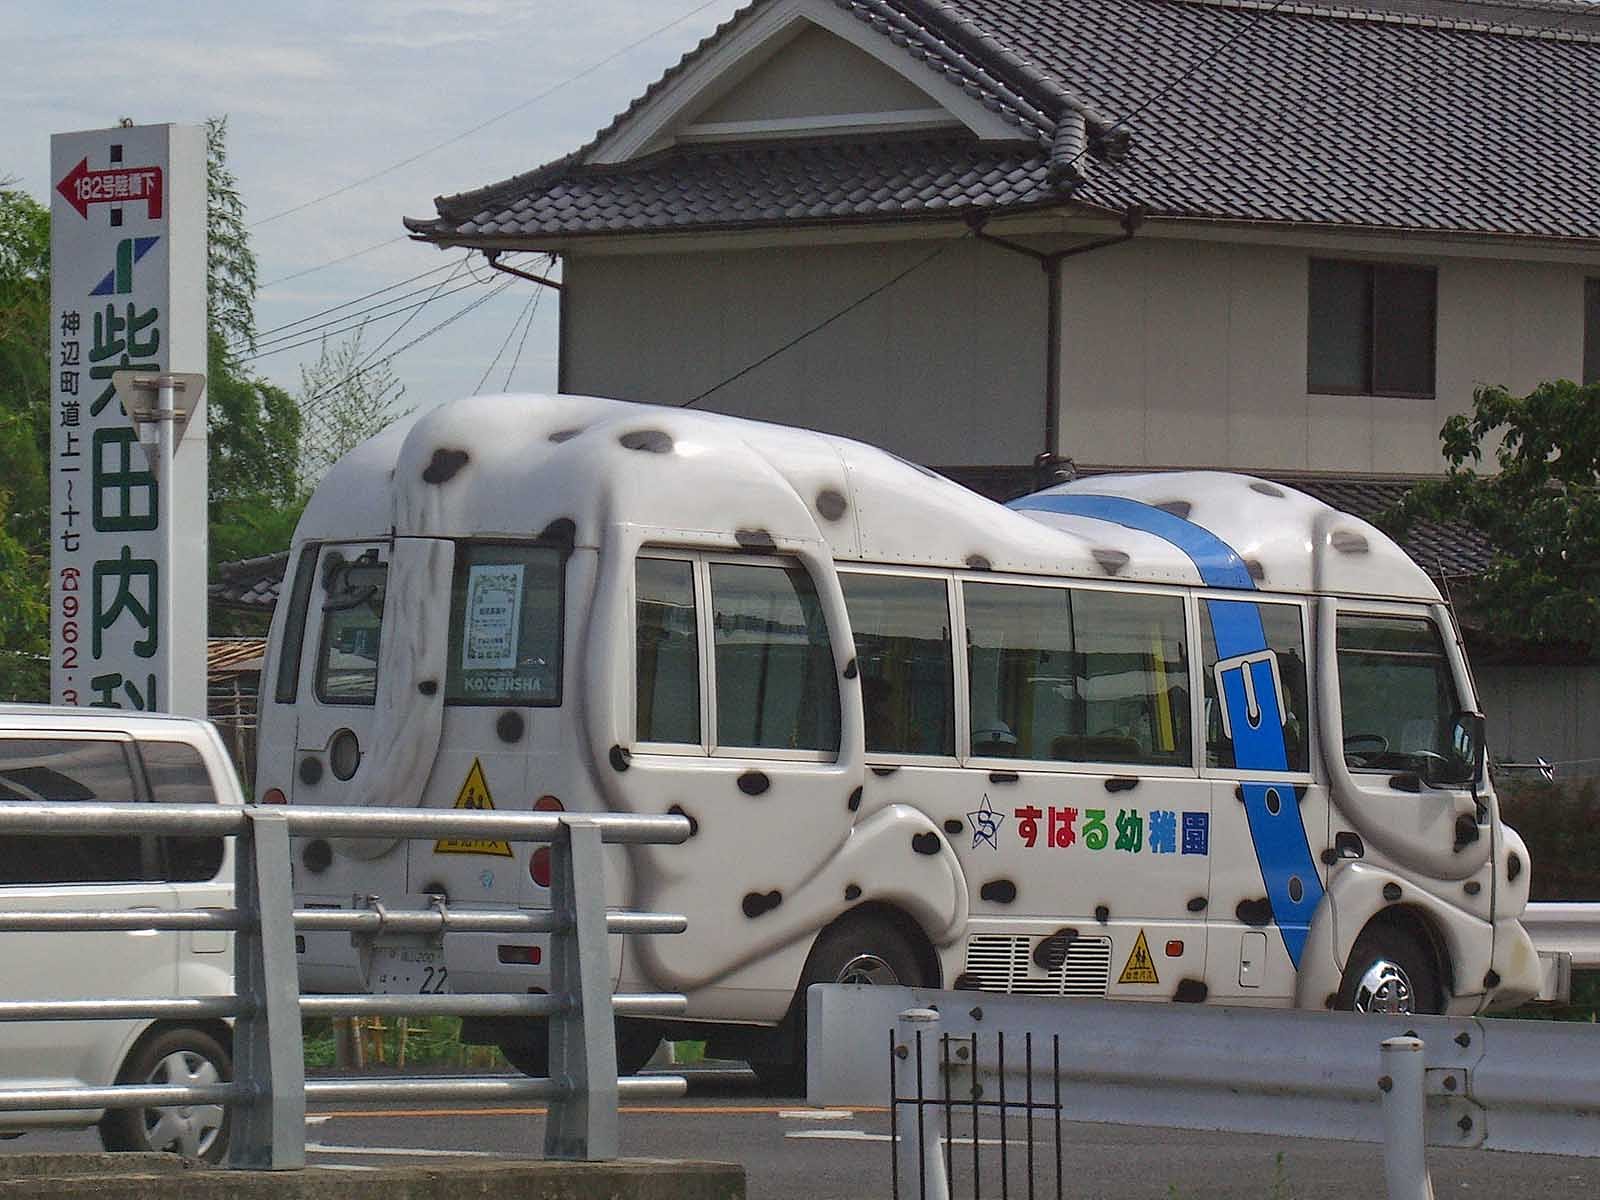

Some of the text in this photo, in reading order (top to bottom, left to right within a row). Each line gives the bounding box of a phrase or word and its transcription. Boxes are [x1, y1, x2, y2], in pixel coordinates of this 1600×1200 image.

[1014, 805, 1209, 856] すばる幼稚園
